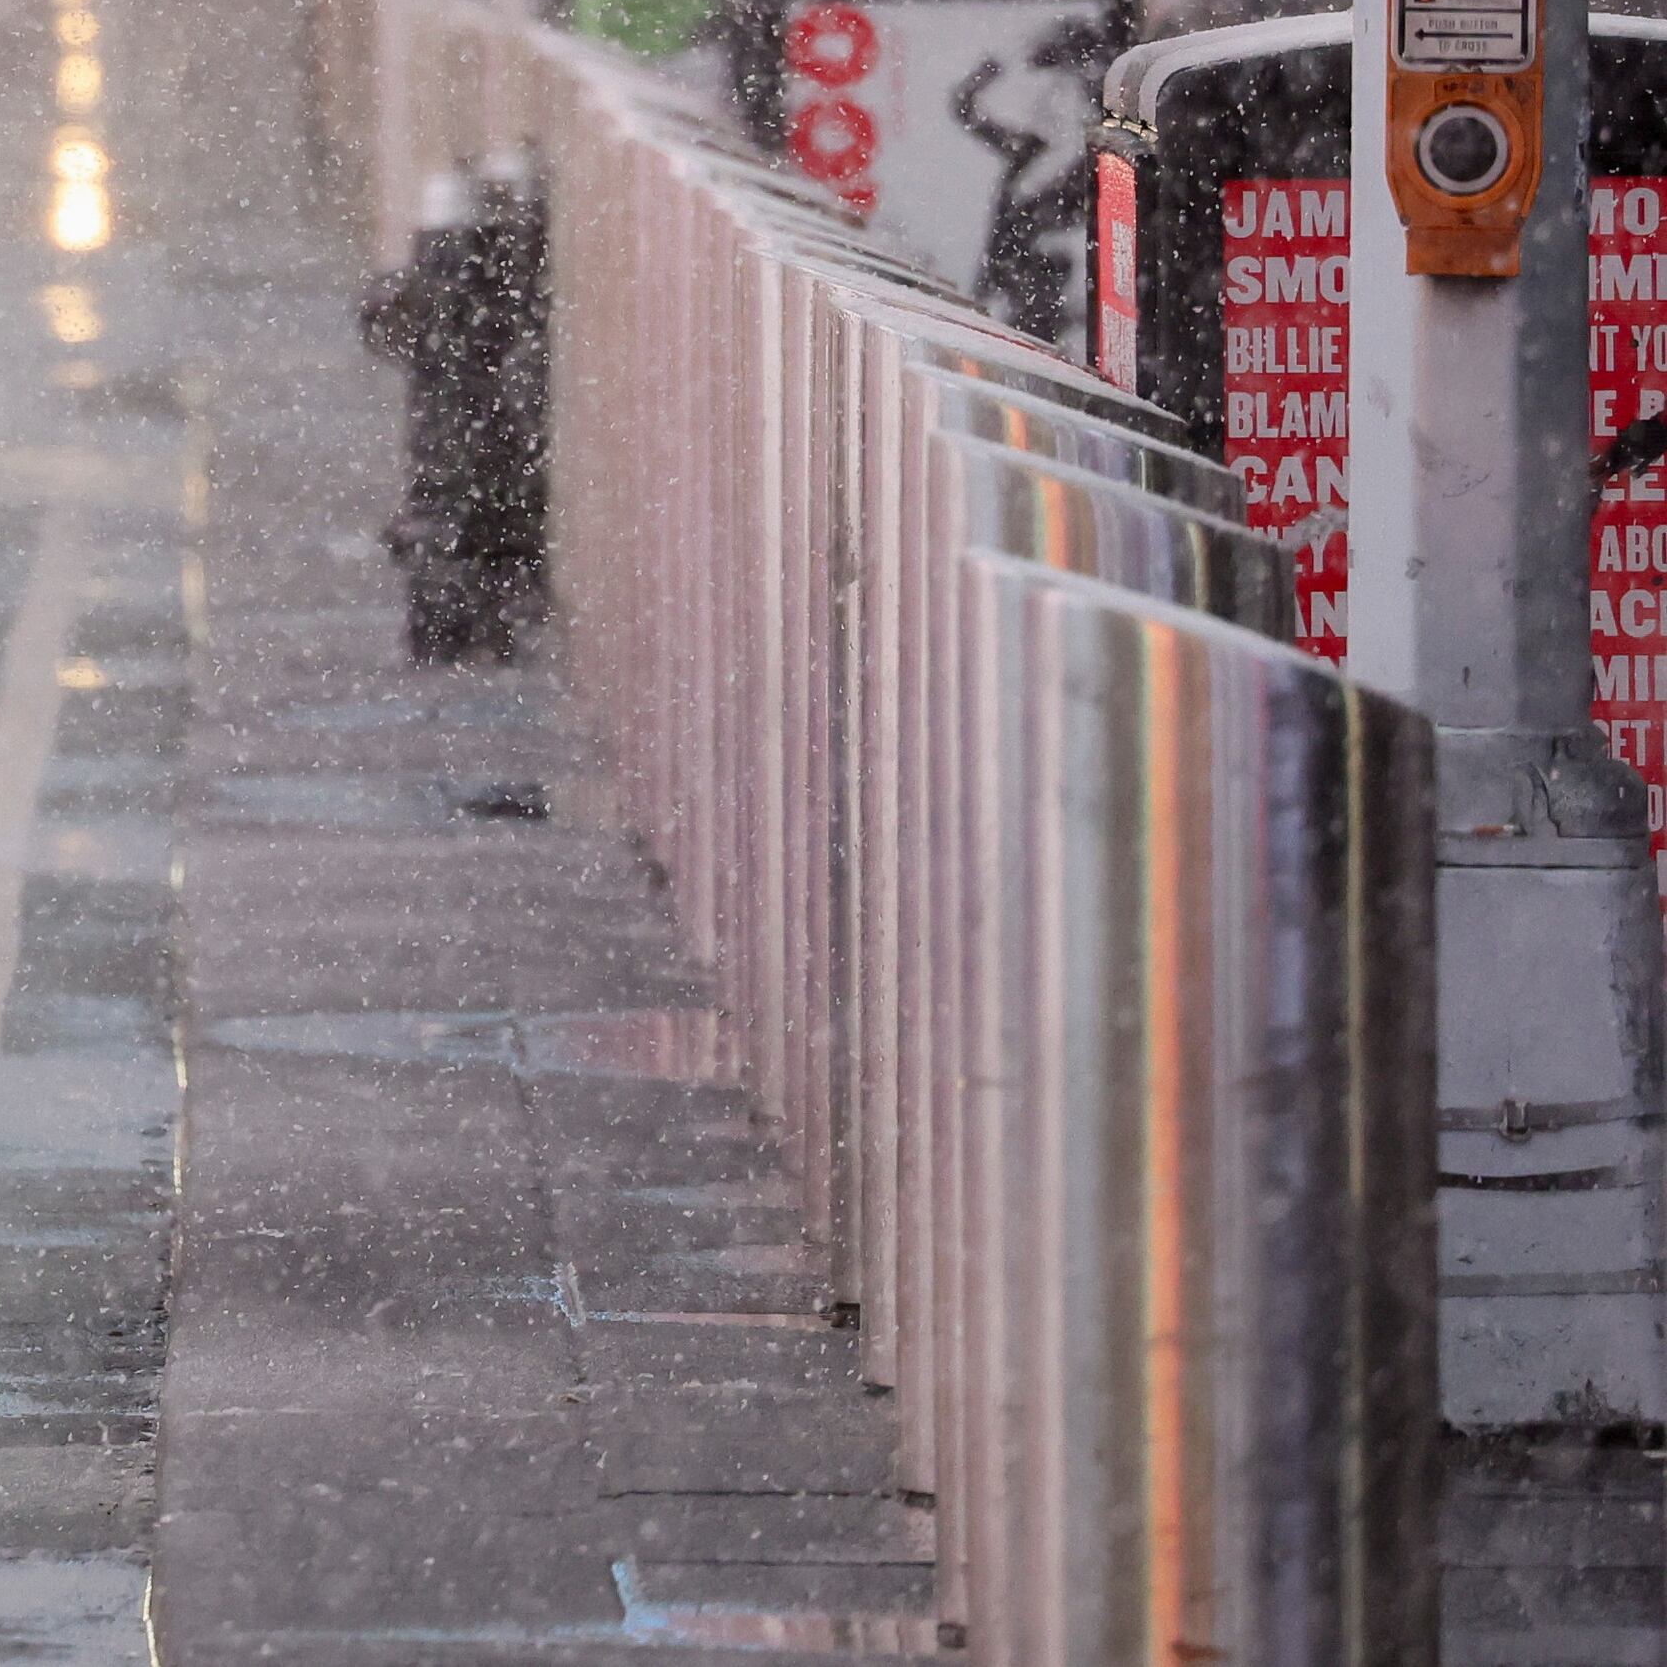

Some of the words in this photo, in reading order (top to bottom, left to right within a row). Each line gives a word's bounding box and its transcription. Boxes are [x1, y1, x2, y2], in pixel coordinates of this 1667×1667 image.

[1428, 18, 1456, 30] PUSH
[1460, 19, 1498, 30] BUTTON
[1439, 40, 1452, 52] TO
[1454, 40, 1488, 53] CROSS
[1225, 191, 1346, 239] JAM
[1227, 327, 1343, 374] BILLIE
[1228, 391, 1347, 438] BLAM
[1229, 455, 1349, 503] CAN
